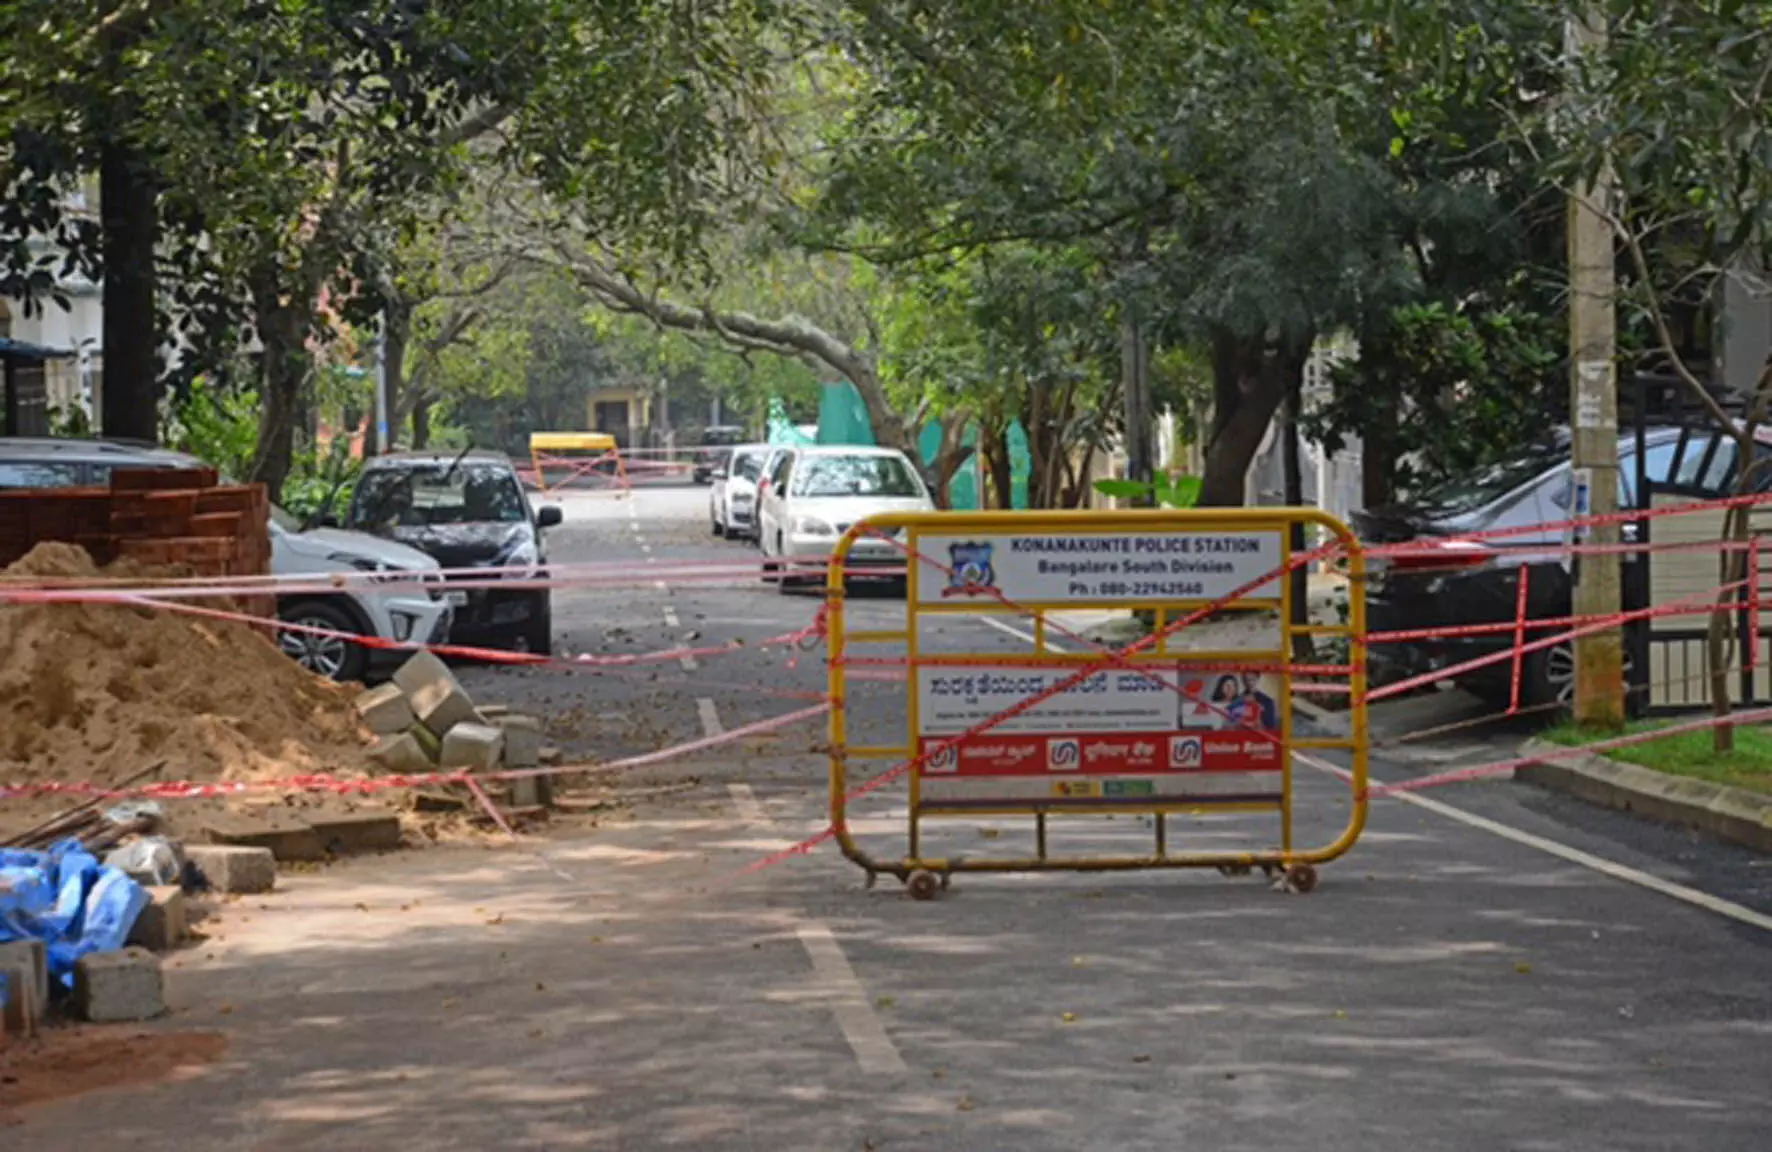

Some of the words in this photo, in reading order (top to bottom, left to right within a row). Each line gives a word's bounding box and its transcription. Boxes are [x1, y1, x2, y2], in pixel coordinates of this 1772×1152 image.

[1011, 537, 1130, 553] KONANAKUNTE
[1135, 537, 1189, 553] POLICE
[1194, 537, 1260, 553] STATION
[1038, 559, 1118, 576] Bangalore
[1122, 559, 1167, 573] South
[1170, 559, 1234, 573] Division
